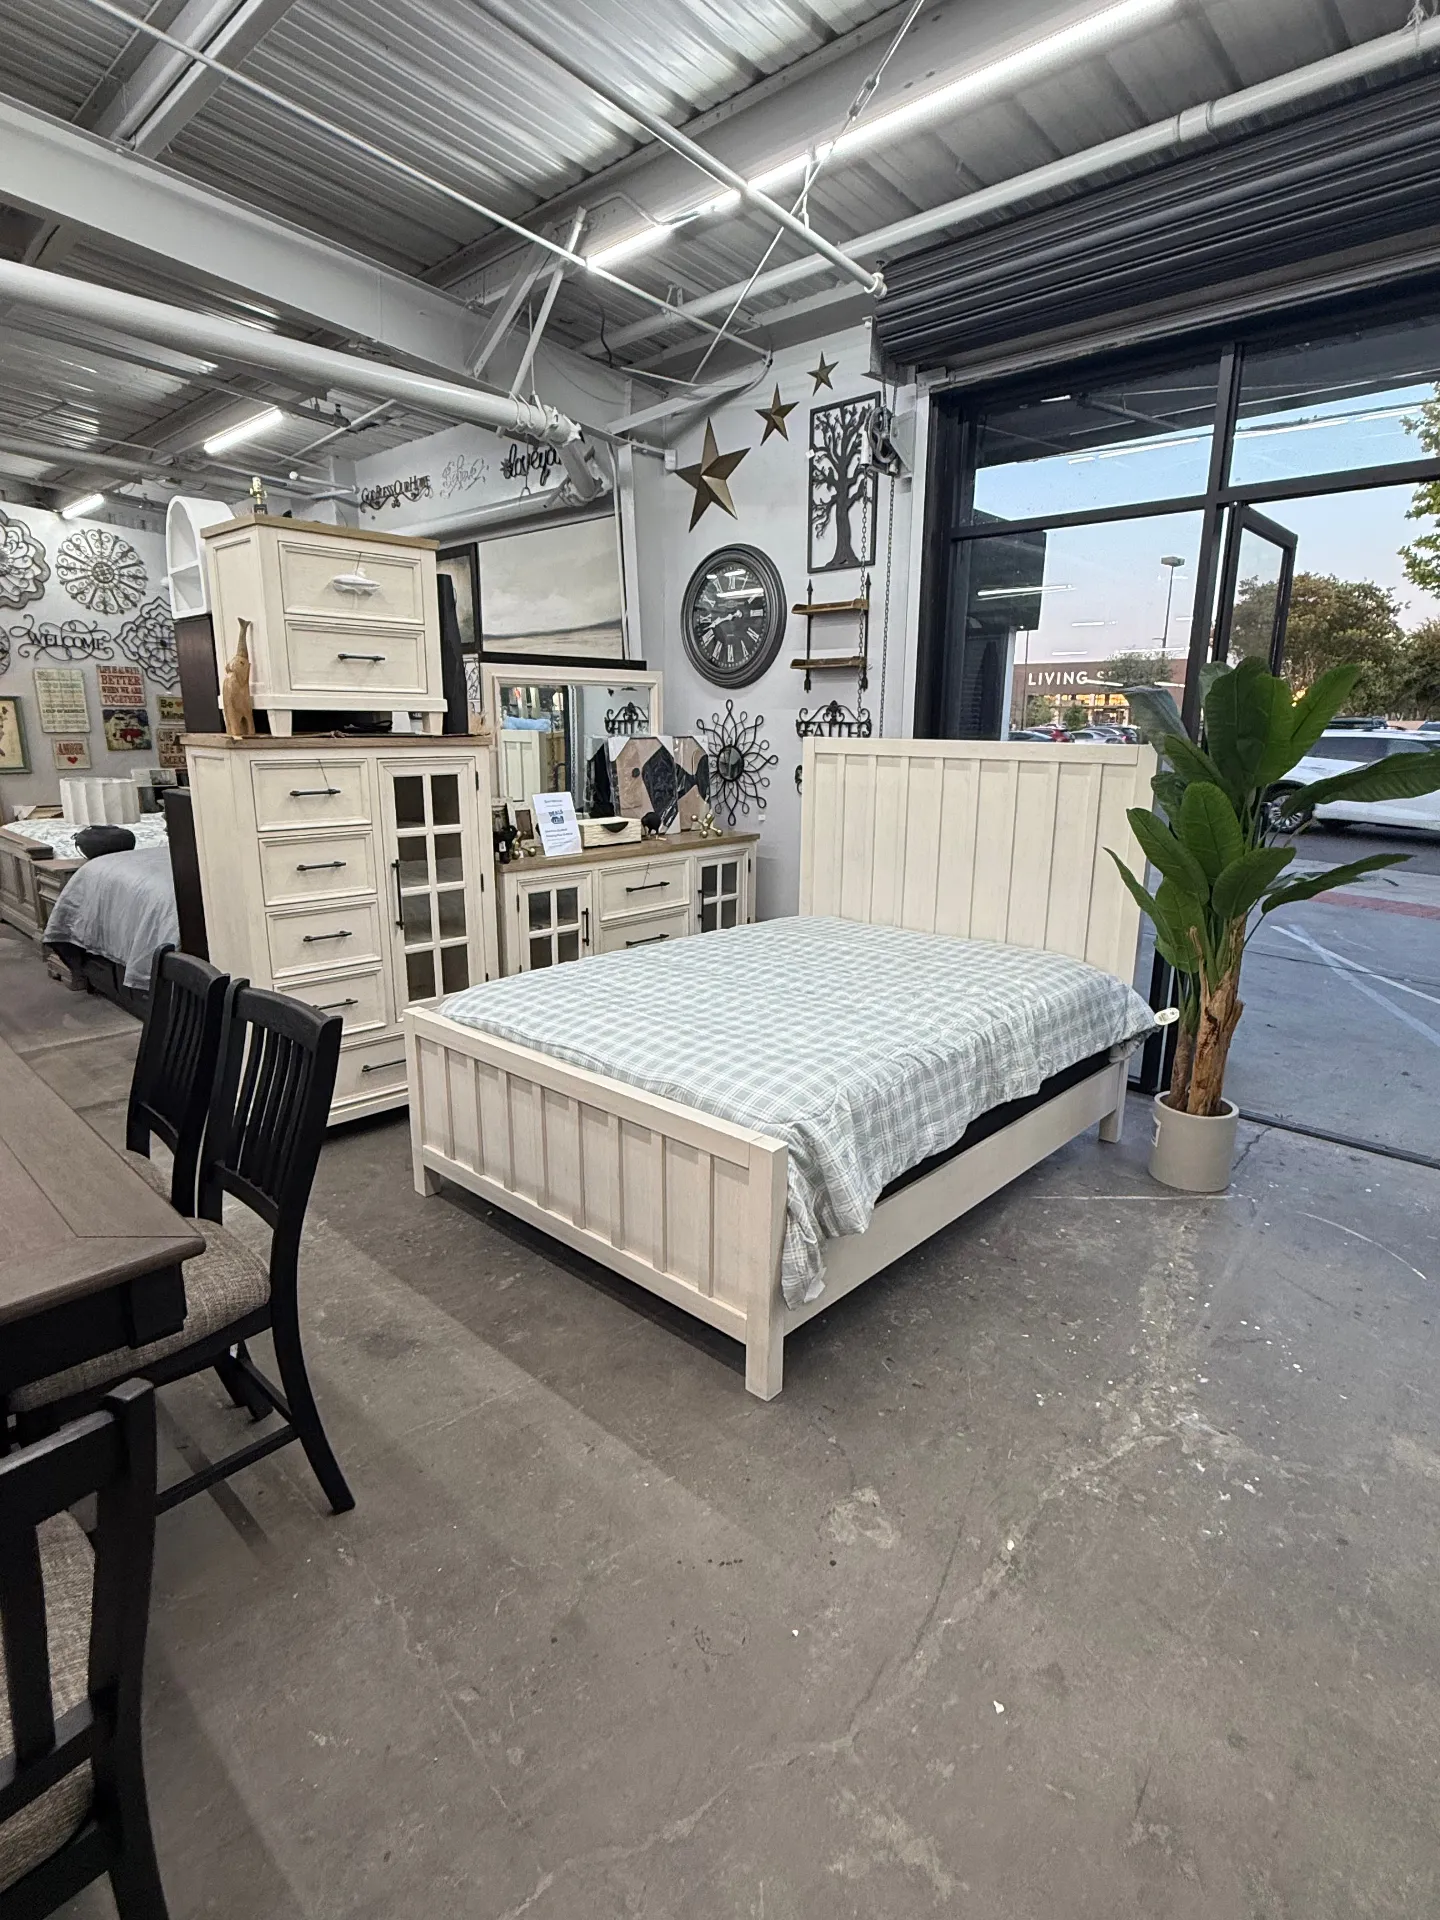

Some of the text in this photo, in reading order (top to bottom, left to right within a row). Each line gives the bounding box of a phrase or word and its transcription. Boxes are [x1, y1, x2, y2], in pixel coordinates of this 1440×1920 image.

[28, 631, 105, 650] WELCOME
[101, 674, 142, 686] BETTER
[1028, 671, 1088, 686] LIVING
[102, 694, 145, 704] TOGETHER
[160, 698, 174, 708] Be
